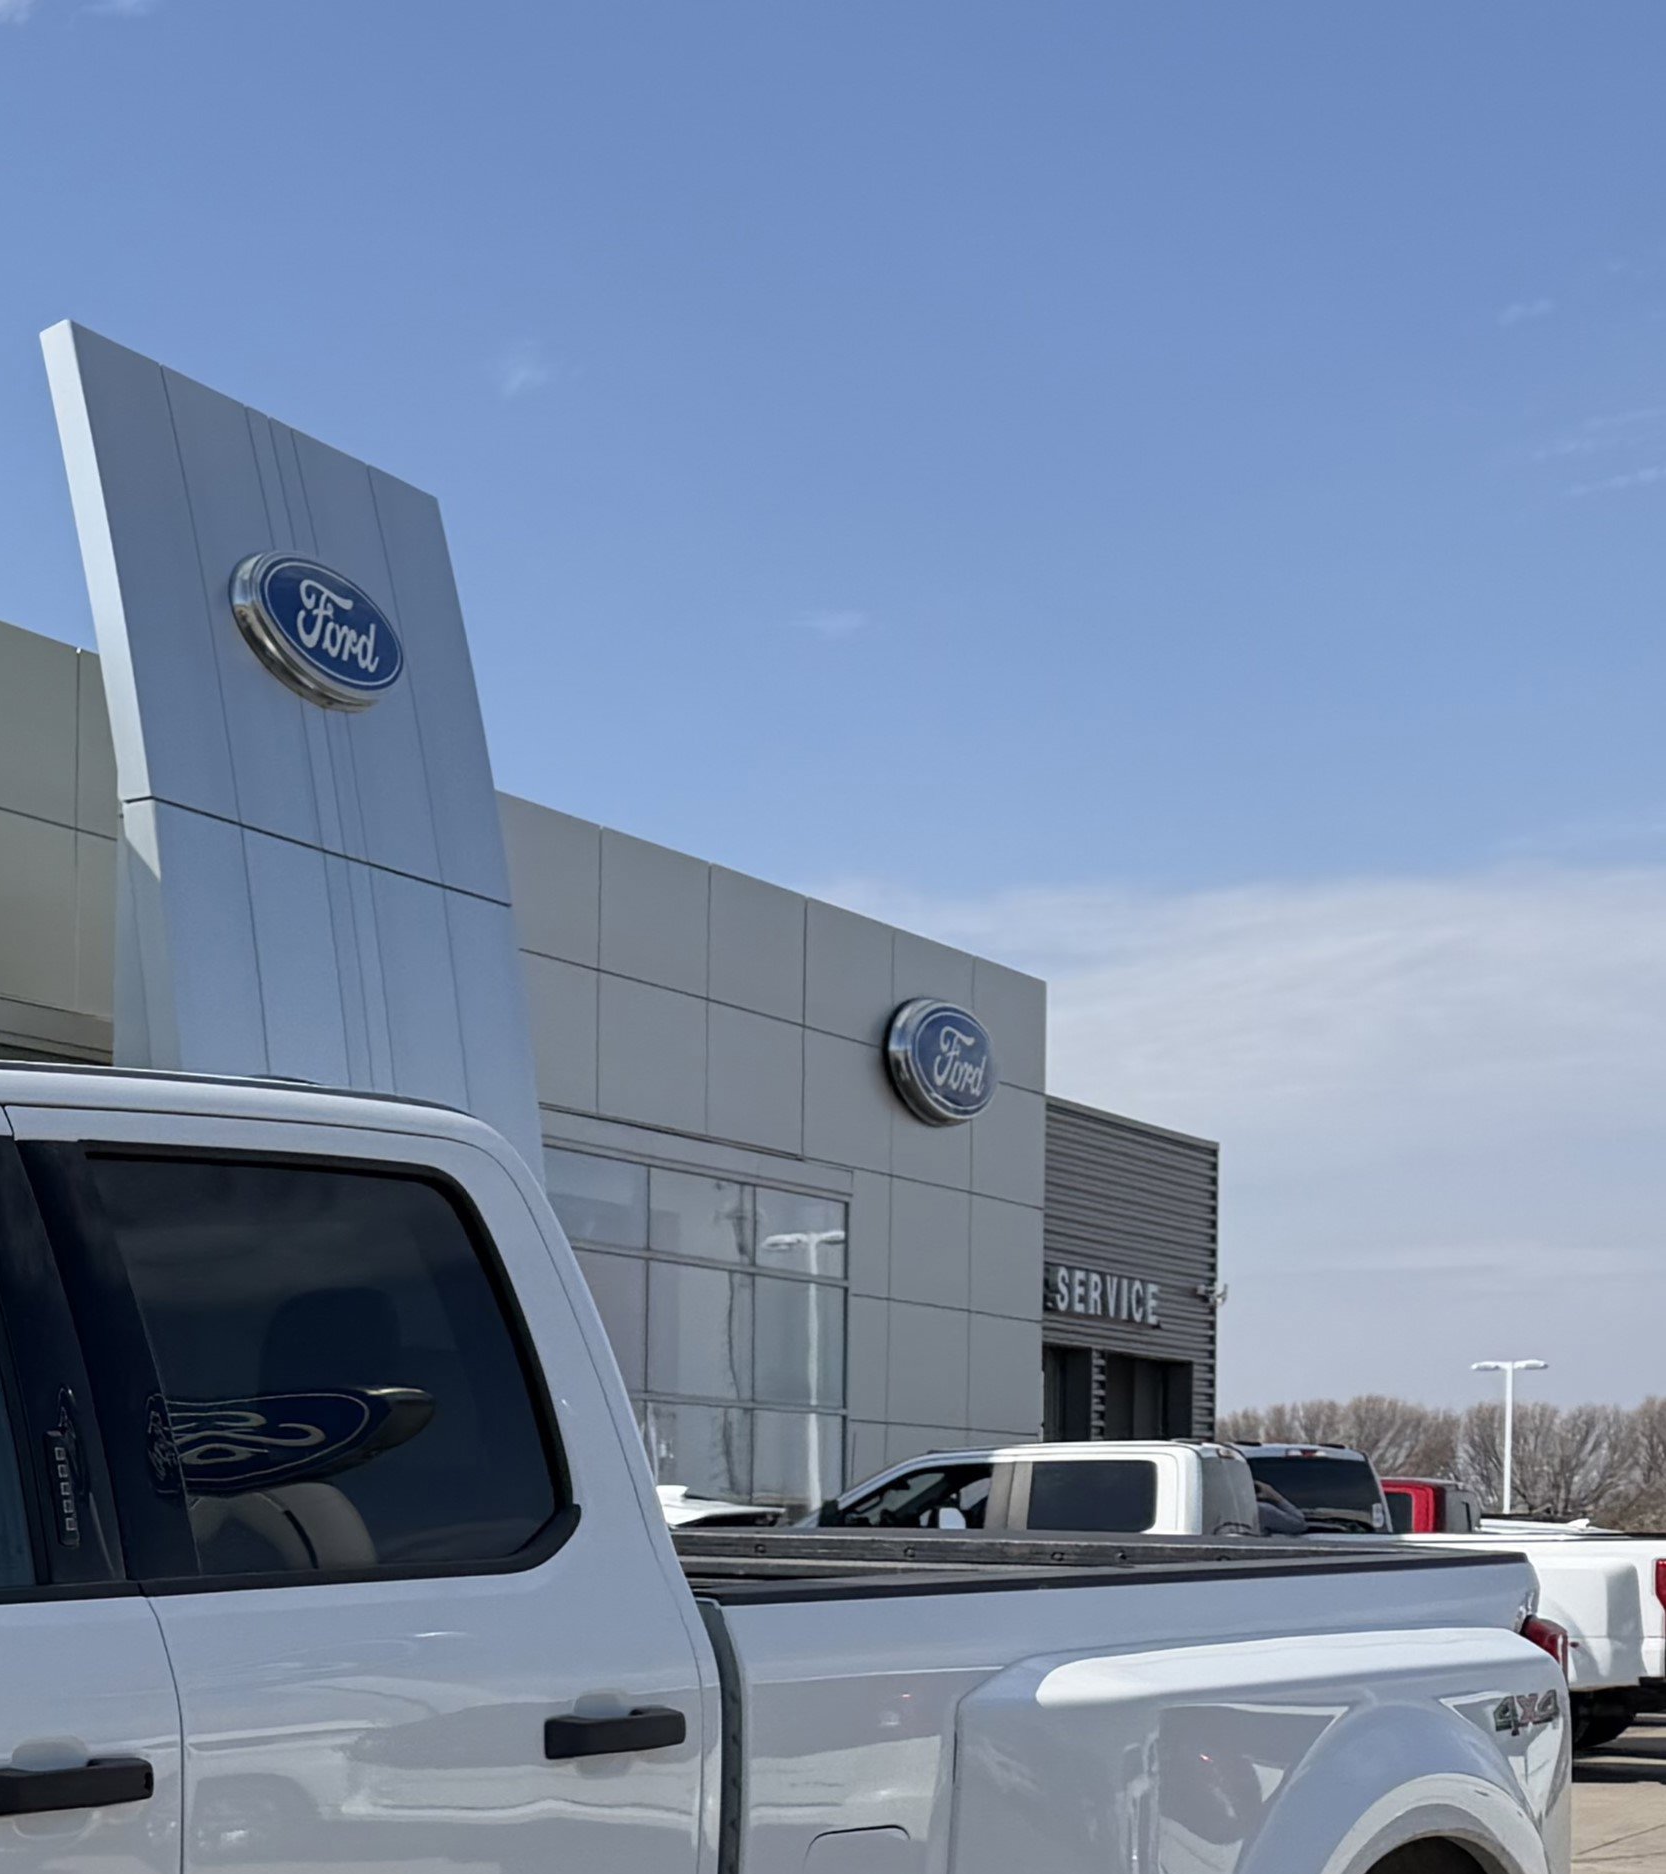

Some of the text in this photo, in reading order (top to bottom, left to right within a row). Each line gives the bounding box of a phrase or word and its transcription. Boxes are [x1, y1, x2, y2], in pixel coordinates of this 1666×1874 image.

[296, 578, 379, 673] Ford
[933, 1025, 987, 1097] Ford
[1055, 1265, 1160, 1326] SERVICE
